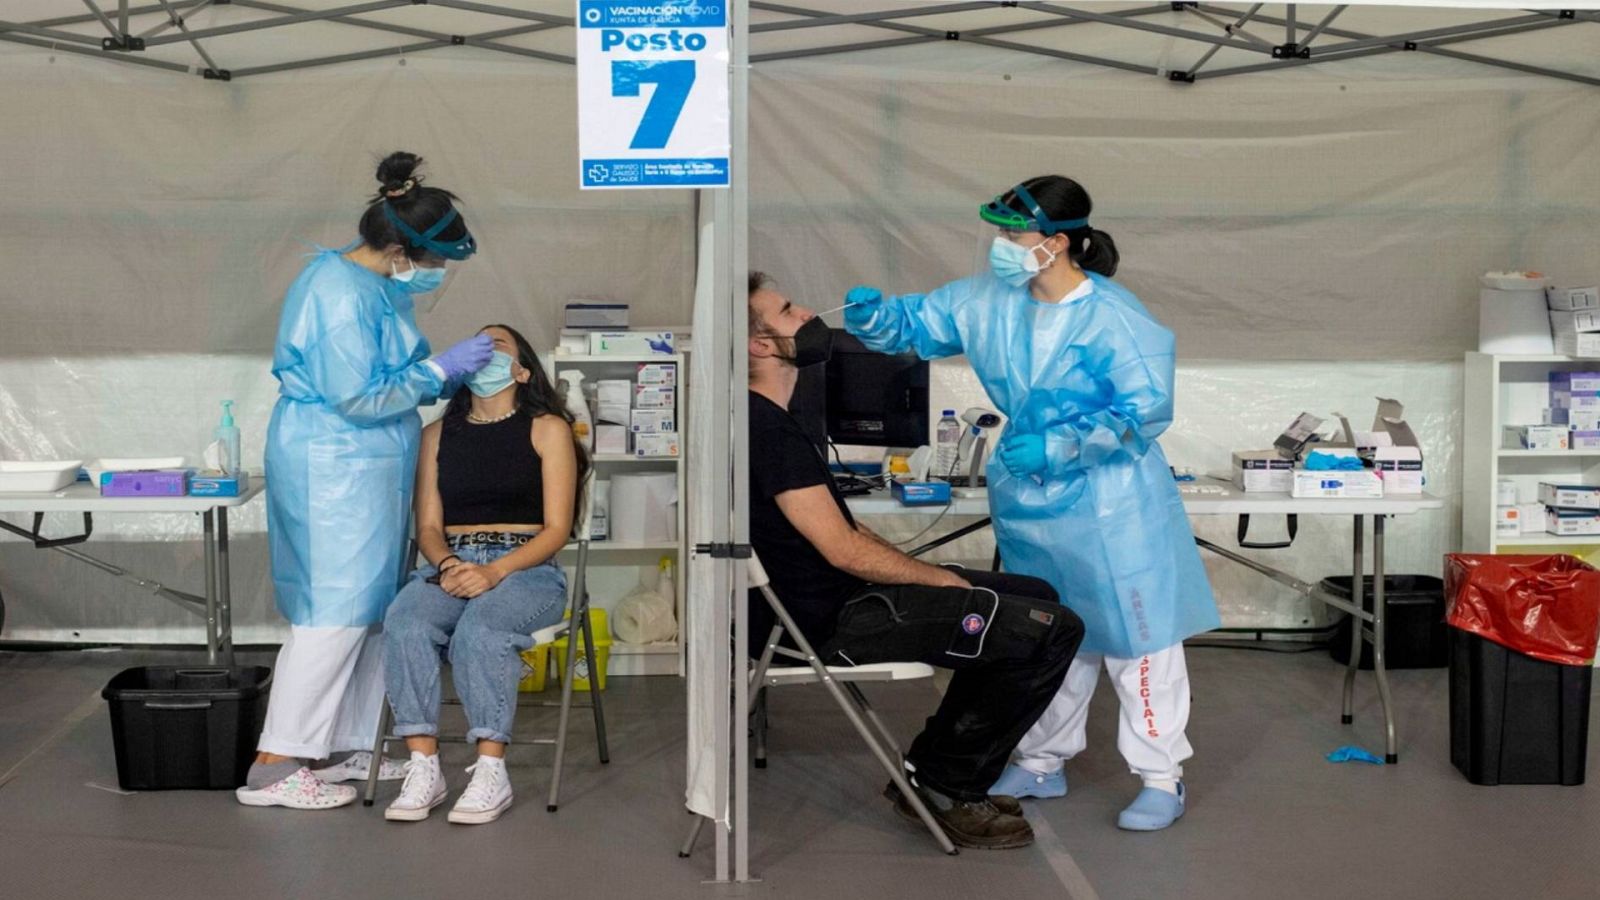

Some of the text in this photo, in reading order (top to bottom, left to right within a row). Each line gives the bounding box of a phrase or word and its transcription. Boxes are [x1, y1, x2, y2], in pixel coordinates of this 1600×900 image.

[601, 29, 706, 51] Posto
[611, 60, 696, 149] 7
[661, 421, 672, 430] M
